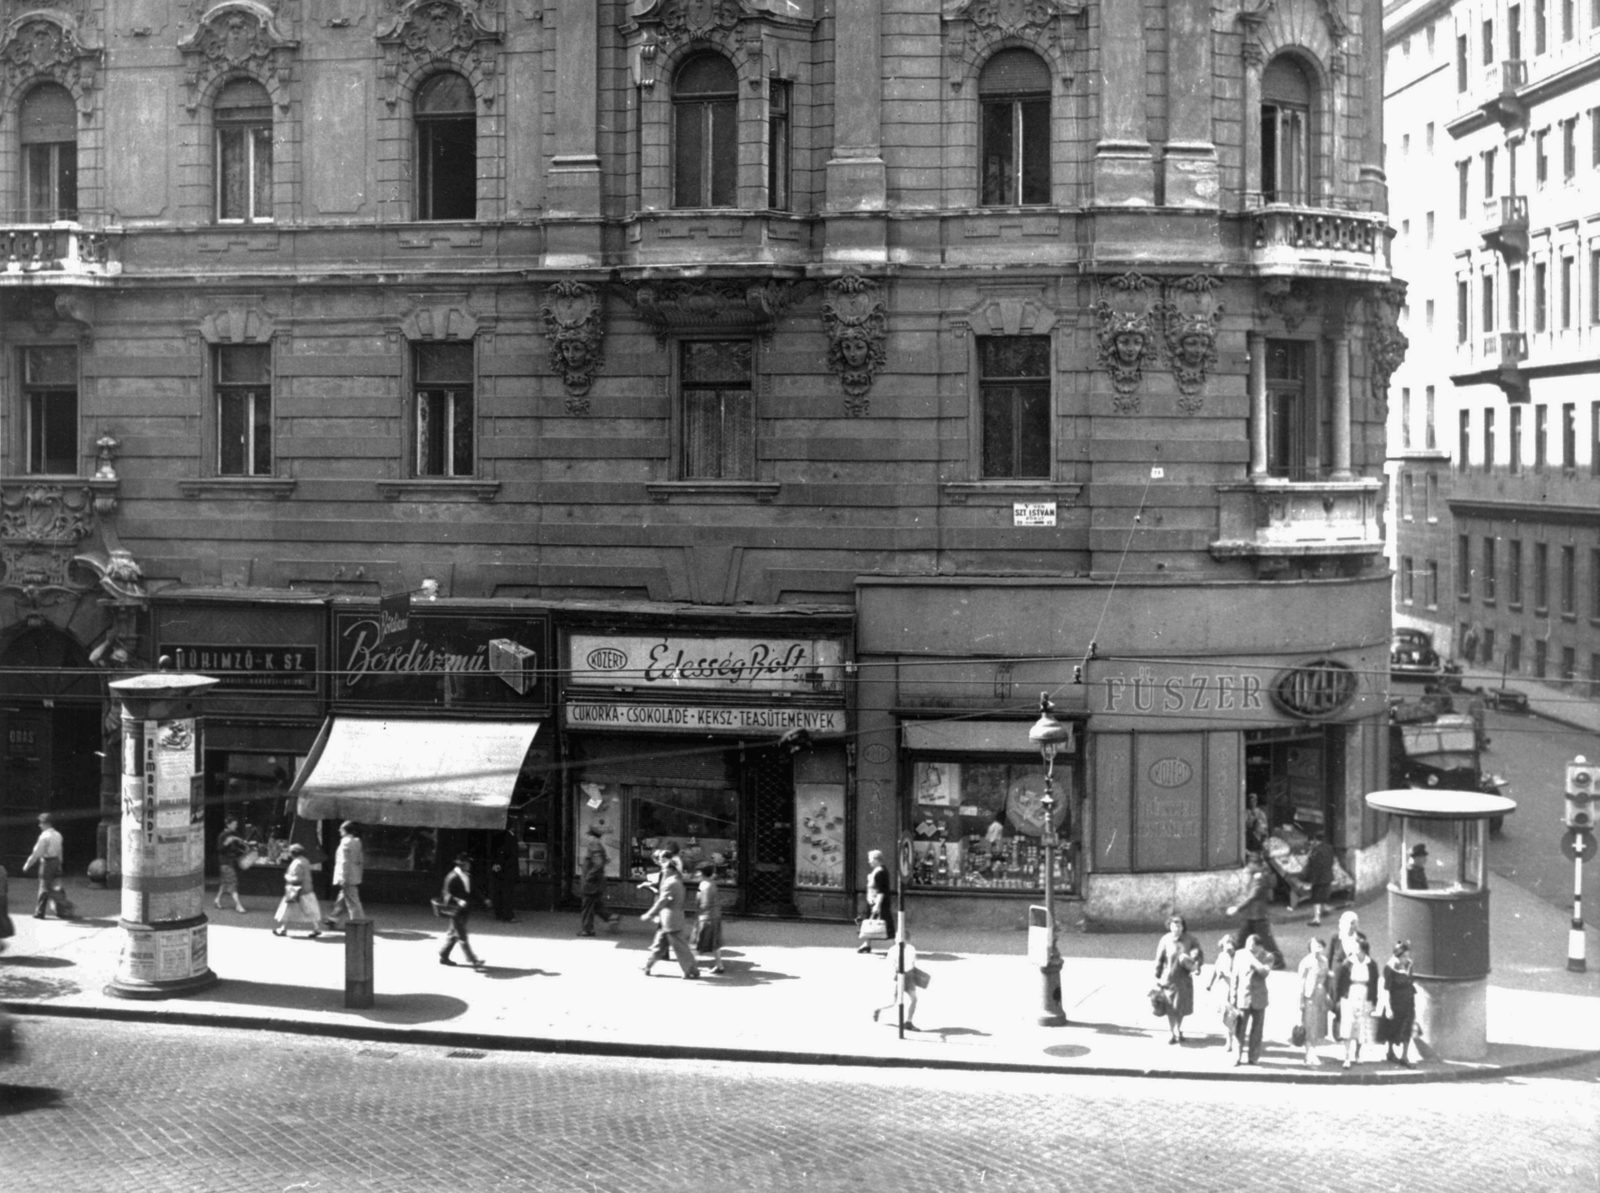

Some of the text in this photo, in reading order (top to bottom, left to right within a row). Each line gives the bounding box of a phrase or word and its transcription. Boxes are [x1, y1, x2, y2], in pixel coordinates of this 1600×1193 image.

[1029, 508, 1055, 517] ISTVÁN
[644, 637, 807, 684] Édesség Bolt
[572, 705, 835, 728] CUKORKA CSOKOLÁDÉ KEKSZ TEASÜTEMÉNYEK
[145, 738, 157, 843] REMBRANDT
